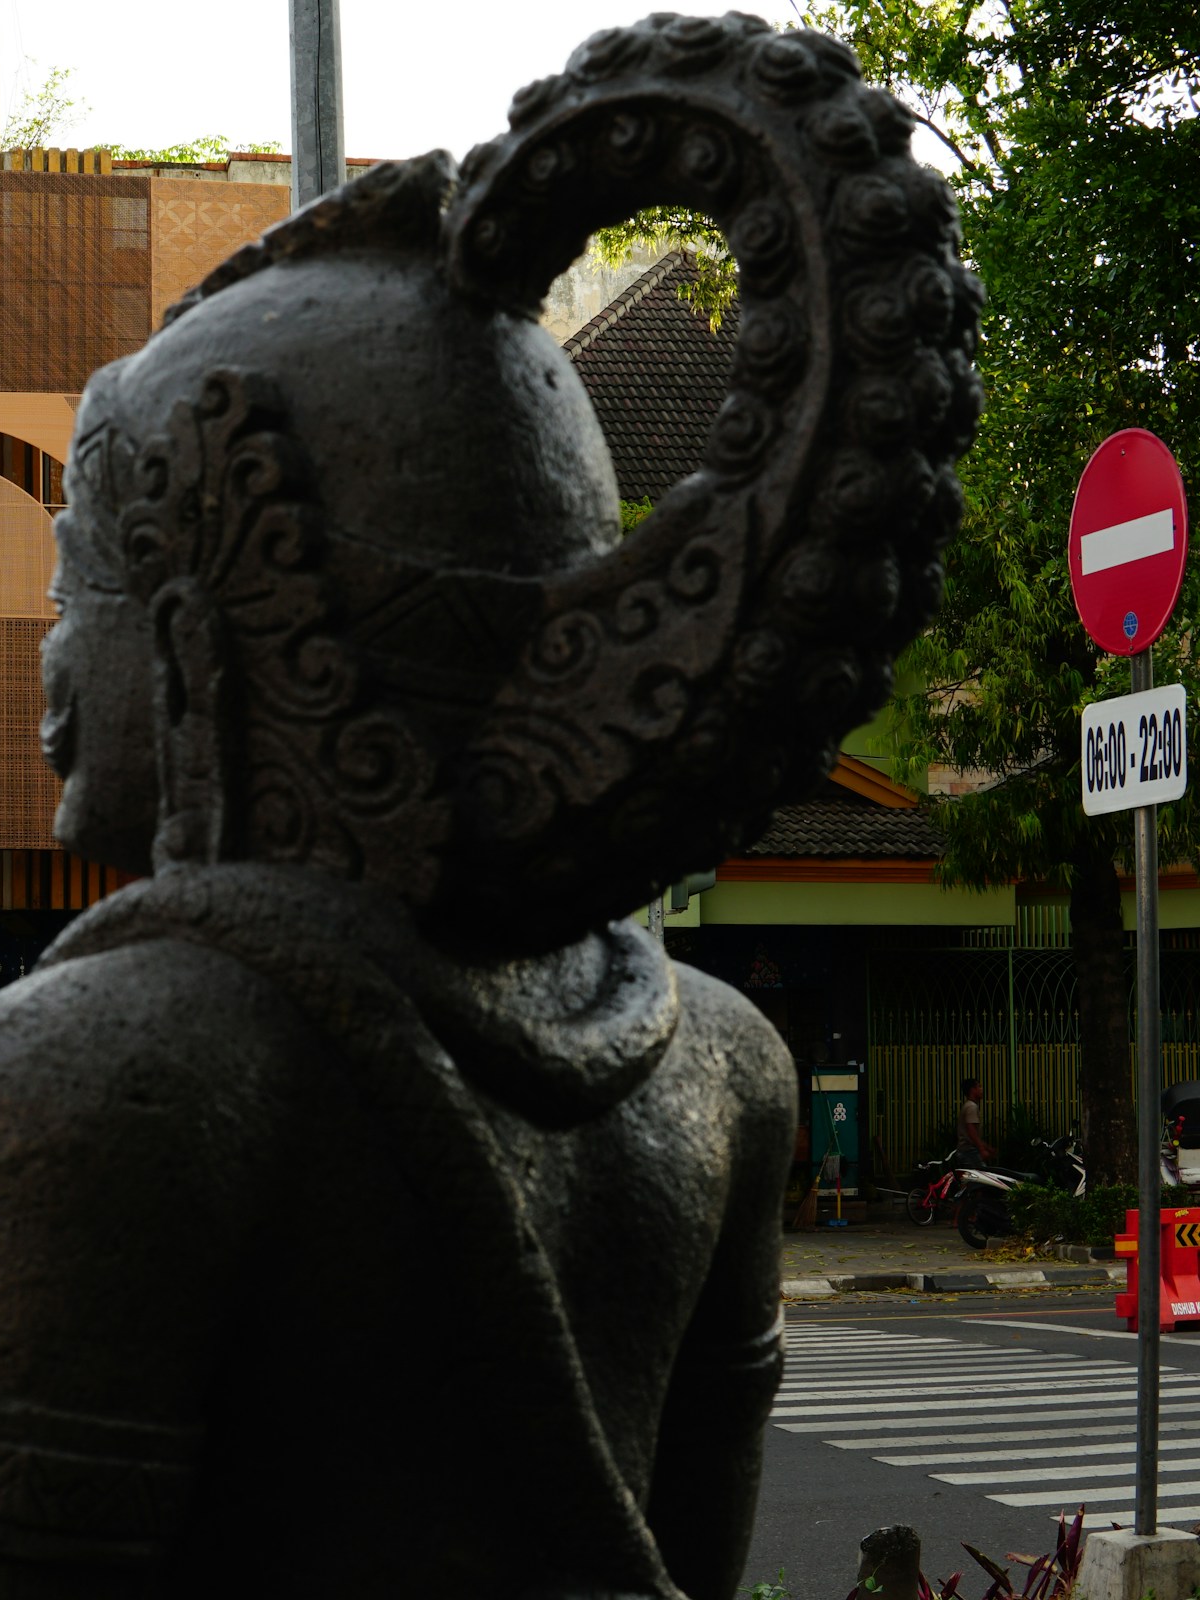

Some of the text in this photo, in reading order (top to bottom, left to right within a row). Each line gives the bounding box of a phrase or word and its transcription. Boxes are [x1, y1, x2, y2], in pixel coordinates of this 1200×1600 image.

[1087, 721, 1125, 792] 06:00
[1140, 708, 1181, 782] 22:00
[1171, 1302, 1196, 1315] DISHUB
